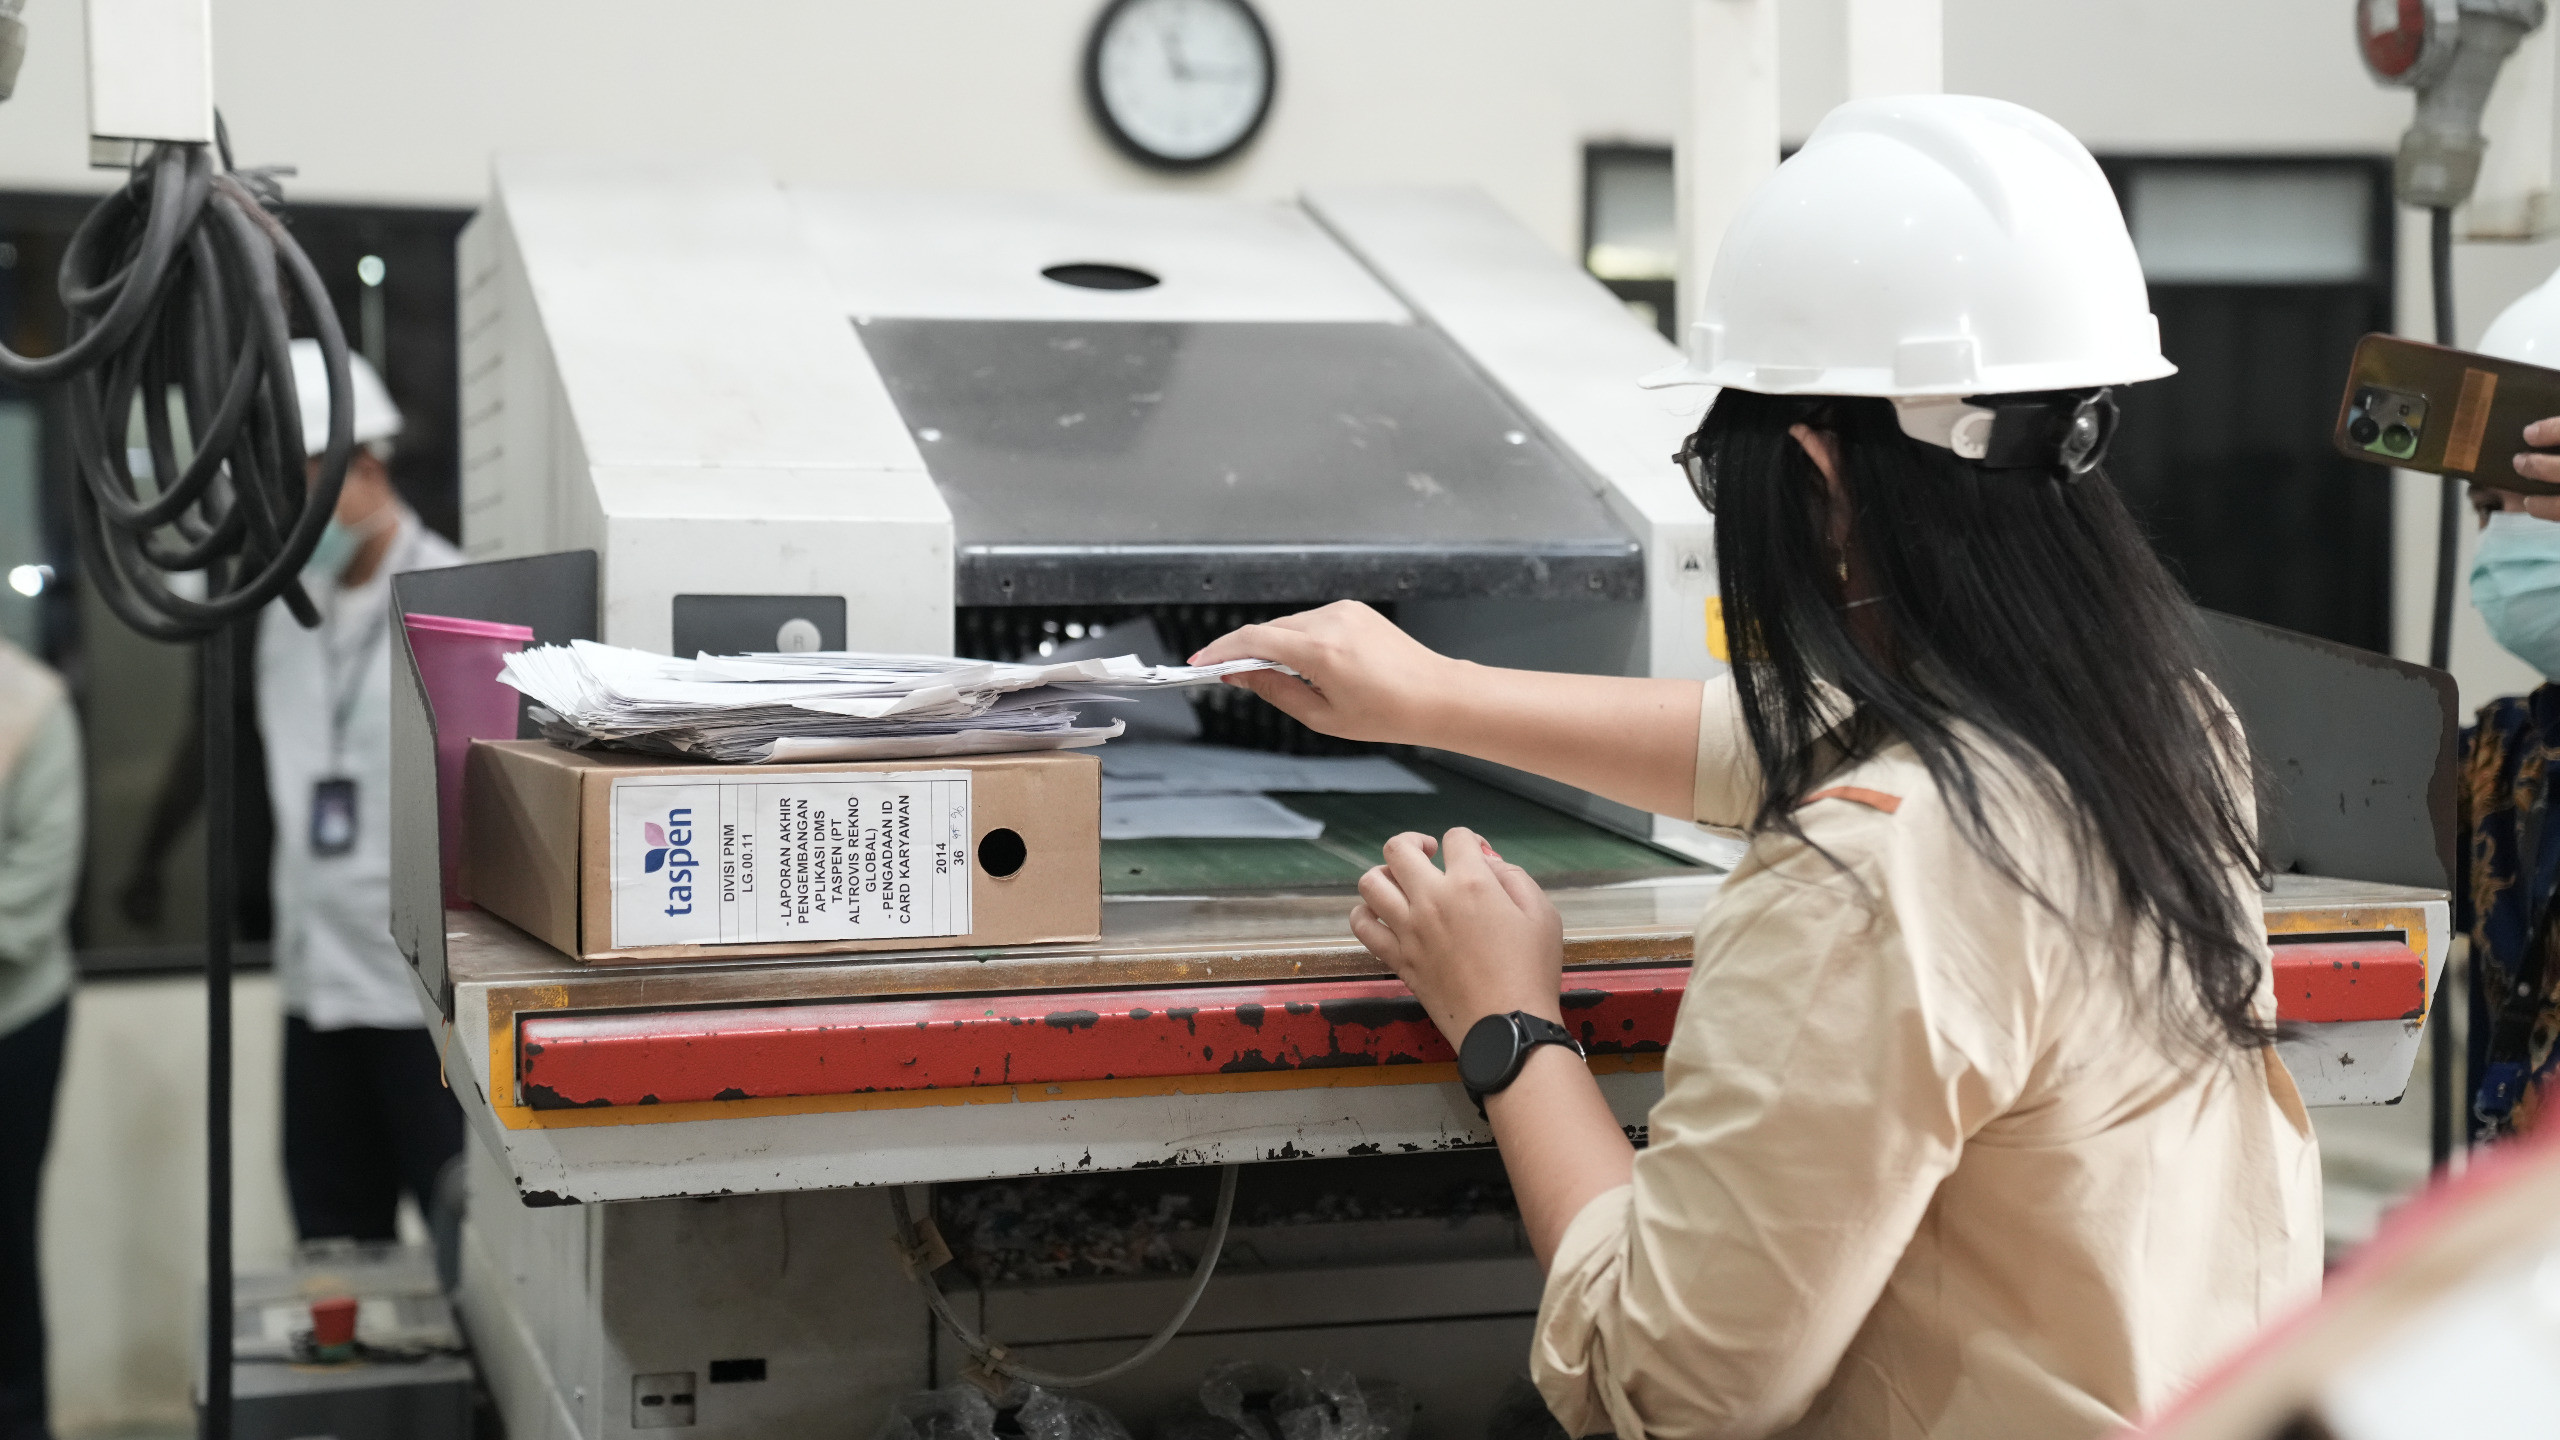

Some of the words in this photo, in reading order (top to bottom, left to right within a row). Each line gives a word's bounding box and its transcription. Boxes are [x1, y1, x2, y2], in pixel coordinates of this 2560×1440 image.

[780, 797, 791, 843] AKHIR
[814, 810, 825, 841] DMS
[831, 818, 844, 841] (PT
[848, 797, 859, 848] REKNO
[882, 800, 893, 814] ID
[665, 808, 699, 917] taspen
[724, 824, 734, 856] PNM
[742, 834, 753, 893] LG.00.11
[797, 799, 809, 924] PENGEMBANGAN
[865, 828, 878, 892] GLOBAL)
[899, 795, 910, 878] KARYAWAN
[936, 842, 947, 874] 2014
[954, 850, 964, 866] 36
[724, 860, 735, 902] DIVISI
[780, 847, 792, 918] LAPORAN
[814, 846, 826, 912] APLIKASI
[831, 846, 843, 903] TASPEN
[848, 853, 860, 924] ALTROVIS
[882, 819, 893, 910] PENGADAAN
[900, 883, 910, 924] CARD
